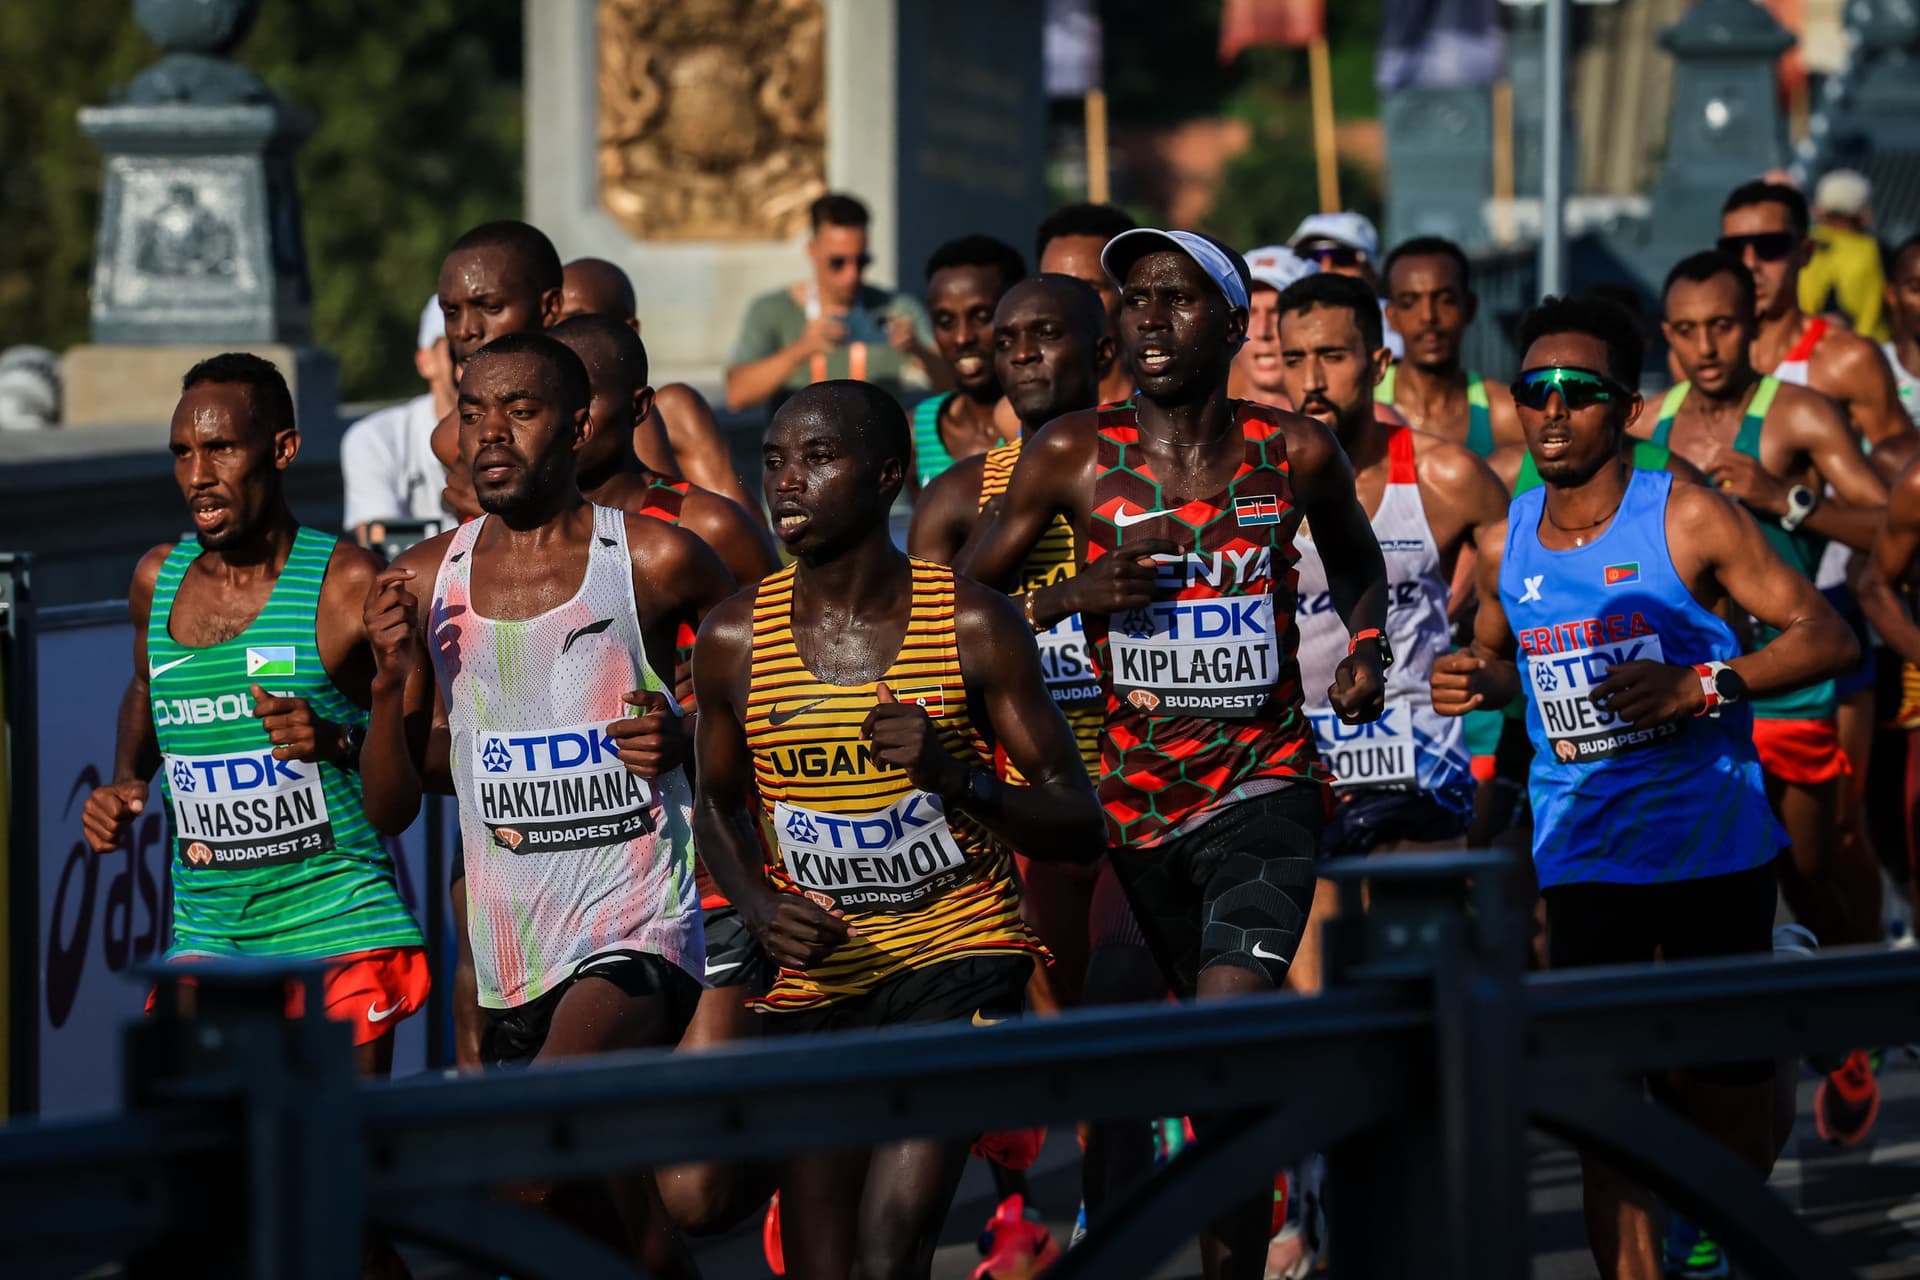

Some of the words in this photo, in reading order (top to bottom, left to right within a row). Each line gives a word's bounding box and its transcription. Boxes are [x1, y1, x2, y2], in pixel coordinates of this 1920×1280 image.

[1150, 546, 1272, 588] ENYA
[1153, 600, 1267, 640] TDK
[1519, 612, 1653, 656] ERITREA
[1120, 643, 1271, 684] KIPLAGAT
[154, 691, 296, 727] DJIBOU
[1165, 694, 1254, 709] BUDAPEST
[1542, 692, 1634, 733] RUES
[1308, 708, 1399, 741] TDK
[1578, 728, 1656, 755] BUDAPEST
[1657, 722, 1677, 737] 23
[508, 729, 620, 772] TDK
[769, 744, 907, 778] UGAN
[191, 754, 305, 793] TDK
[179, 800, 196, 835] I.
[195, 786, 318, 838] HASSAN
[480, 770, 645, 819] HAKIZIMANA
[528, 823, 621, 845] BUDAPEST
[622, 815, 643, 834] 23
[814, 795, 931, 849] TDK
[215, 839, 300, 863] BUDAPEST
[301, 832, 322, 850] 23
[790, 831, 952, 887] KWEMOI
[840, 884, 934, 906] BUDAPEST
[935, 872, 957, 888] 23
